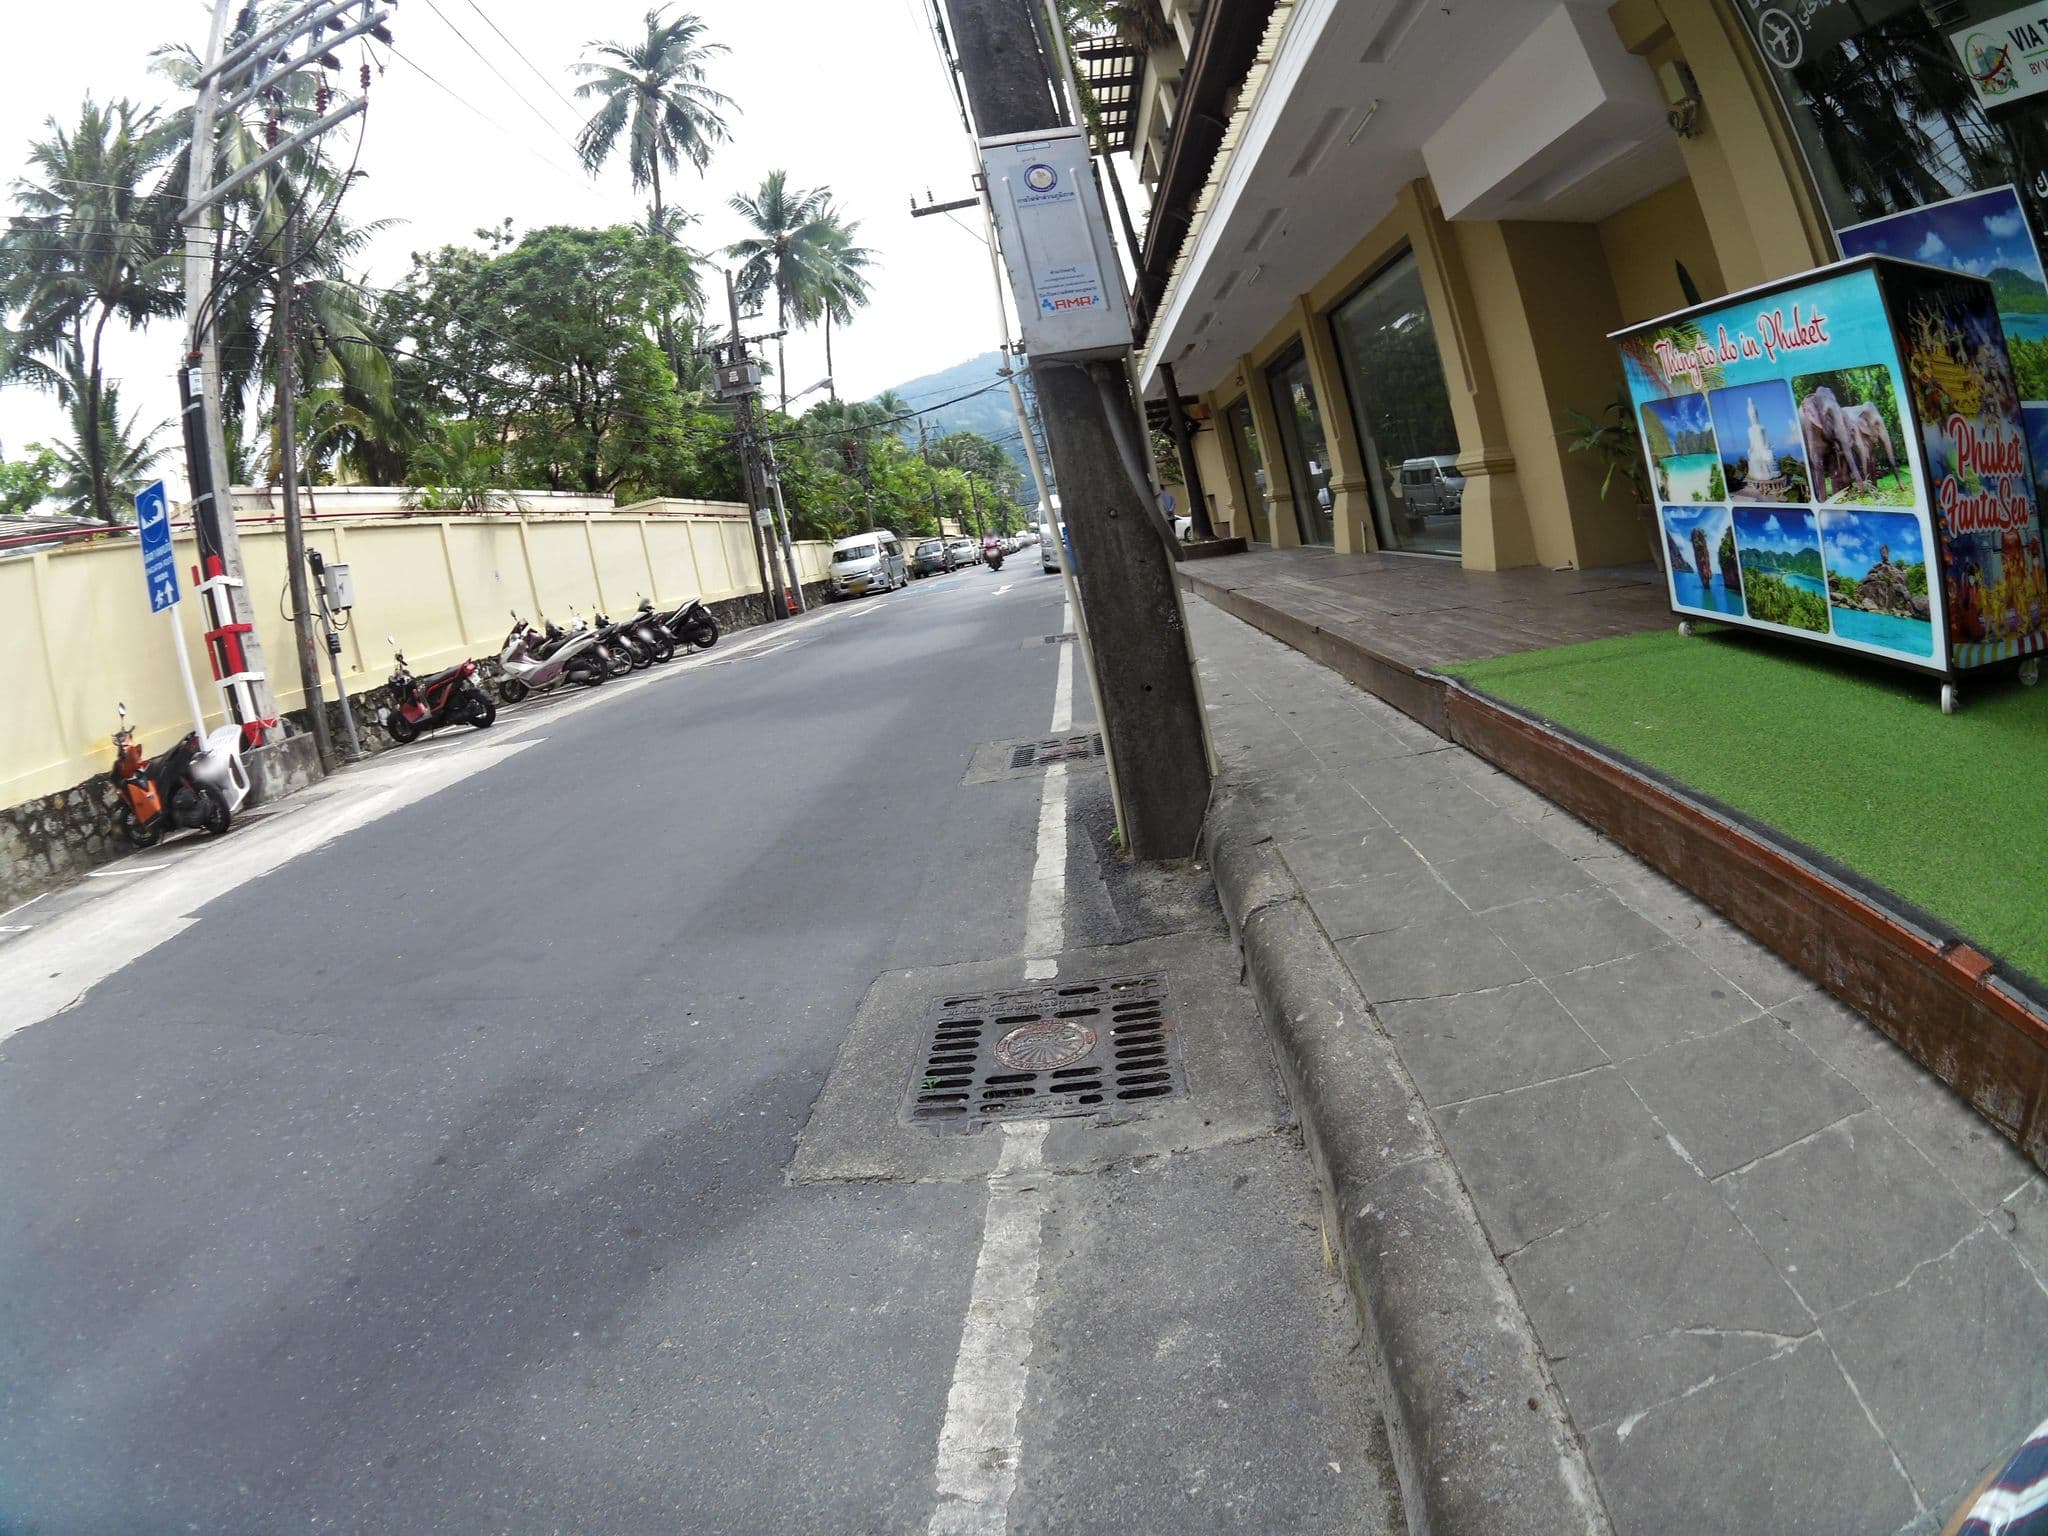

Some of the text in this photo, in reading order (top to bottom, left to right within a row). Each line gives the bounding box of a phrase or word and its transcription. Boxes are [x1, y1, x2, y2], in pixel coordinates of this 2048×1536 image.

[2007, 24, 2044, 51] VIA
[2029, 60, 2042, 75] BY
[1654, 303, 1830, 389] Thing to do in Phuket
[1948, 413, 2024, 480] Phuket
